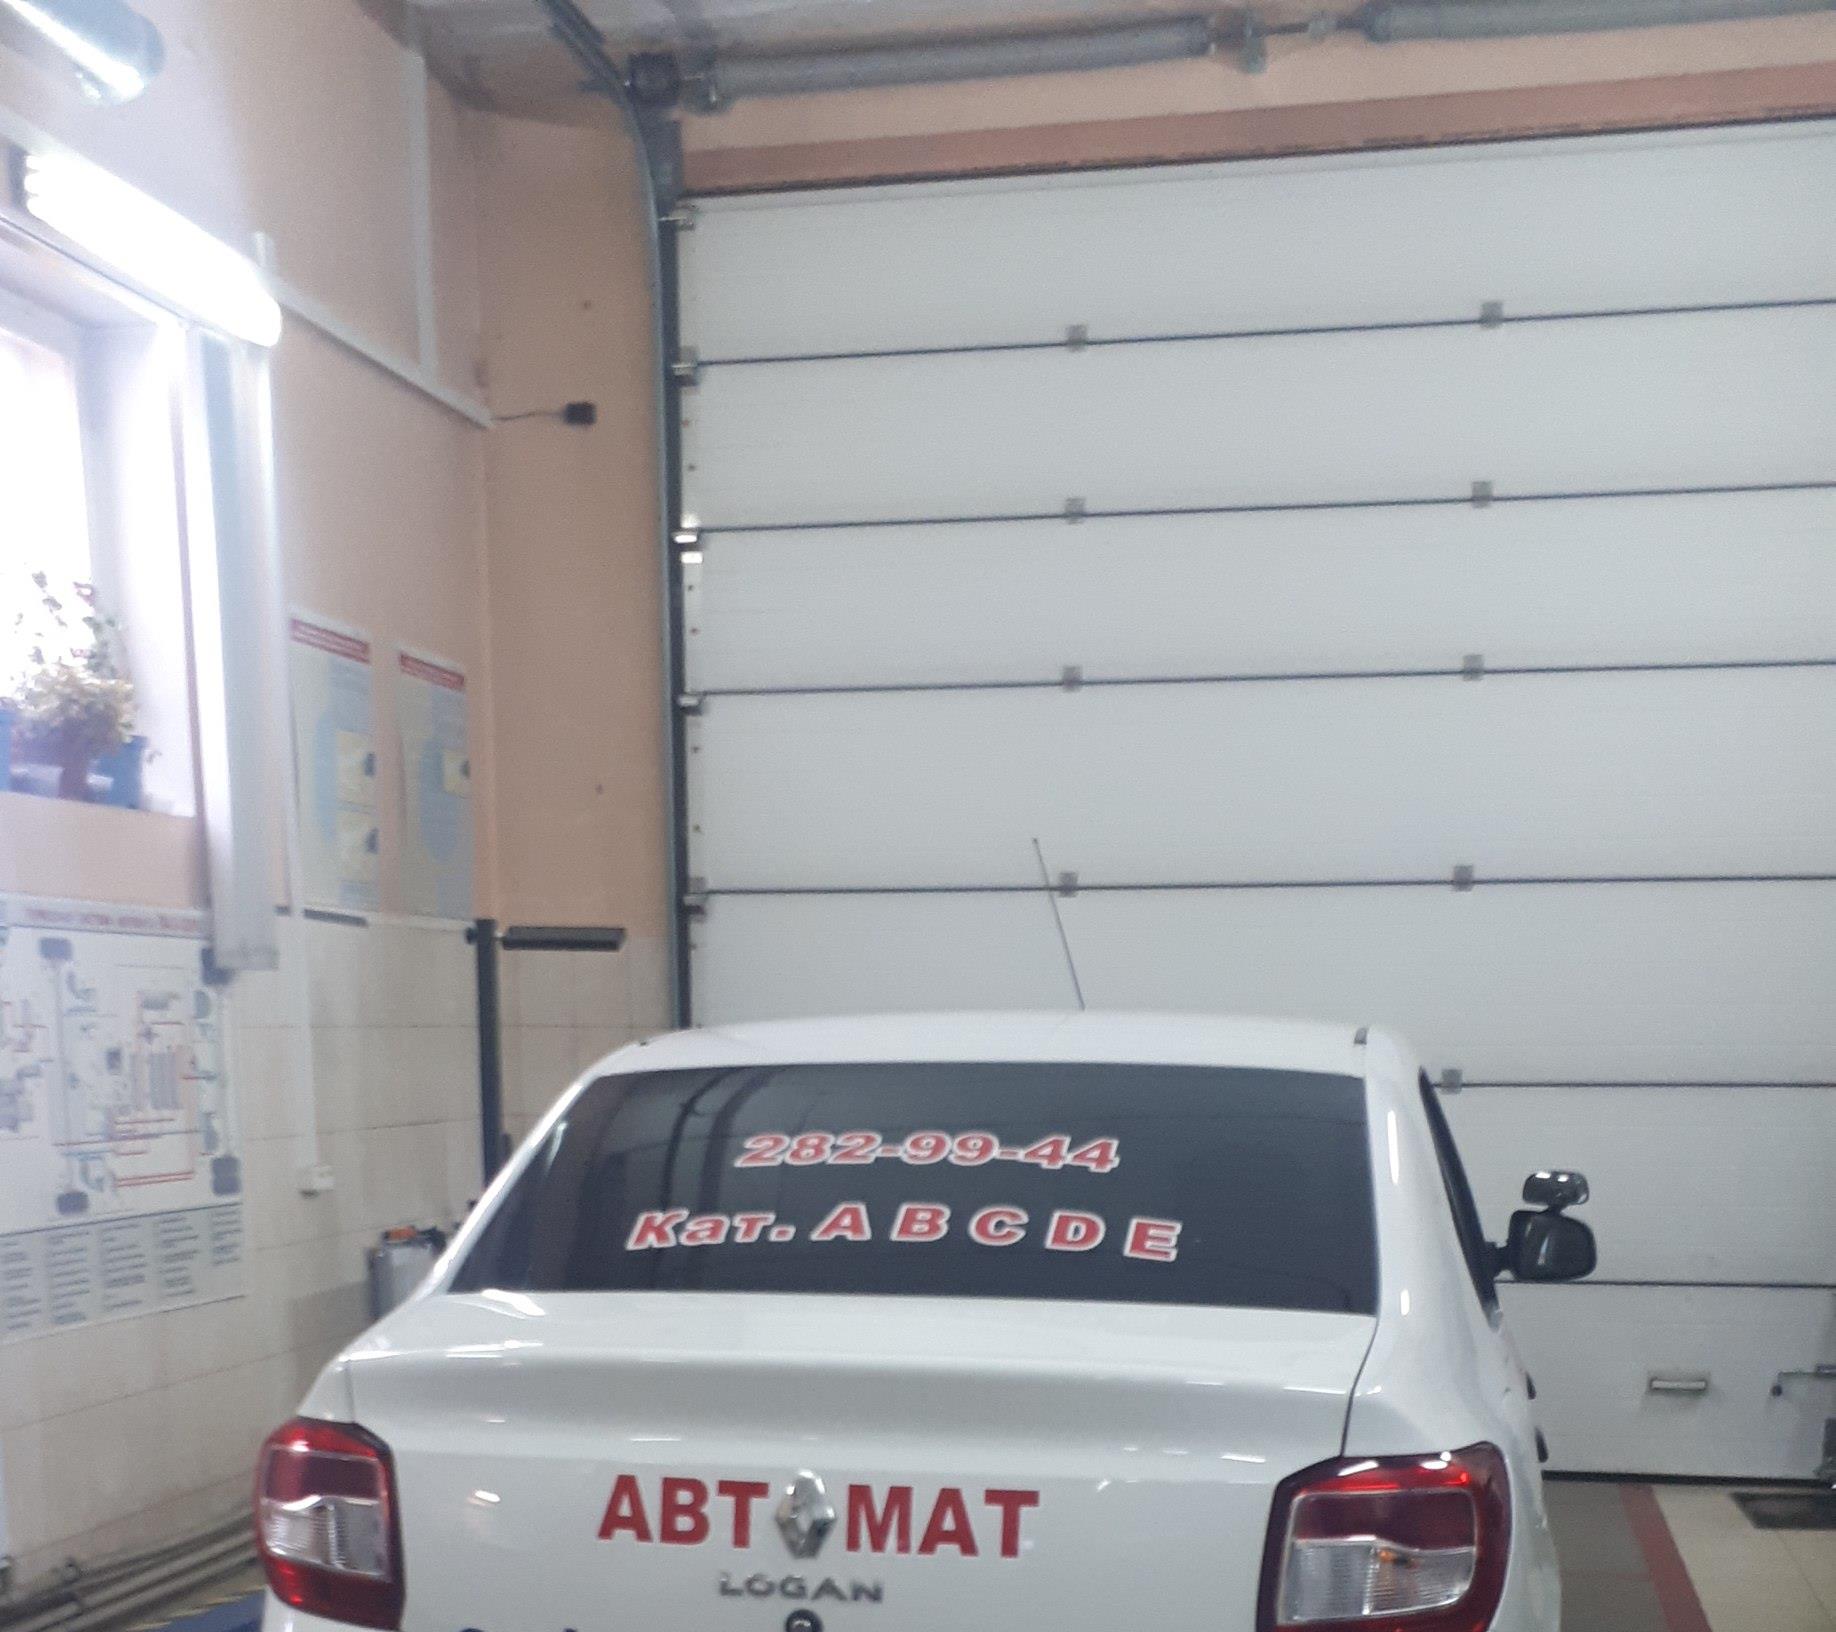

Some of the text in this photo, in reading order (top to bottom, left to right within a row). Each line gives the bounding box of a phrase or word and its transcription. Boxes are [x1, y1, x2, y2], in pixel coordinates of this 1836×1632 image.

[734, 1132, 1120, 1172] 282-99-44
[626, 1209, 796, 1250] Кат.
[1045, 1211, 1107, 1252] D
[718, 1571, 885, 1604] LOGAN
